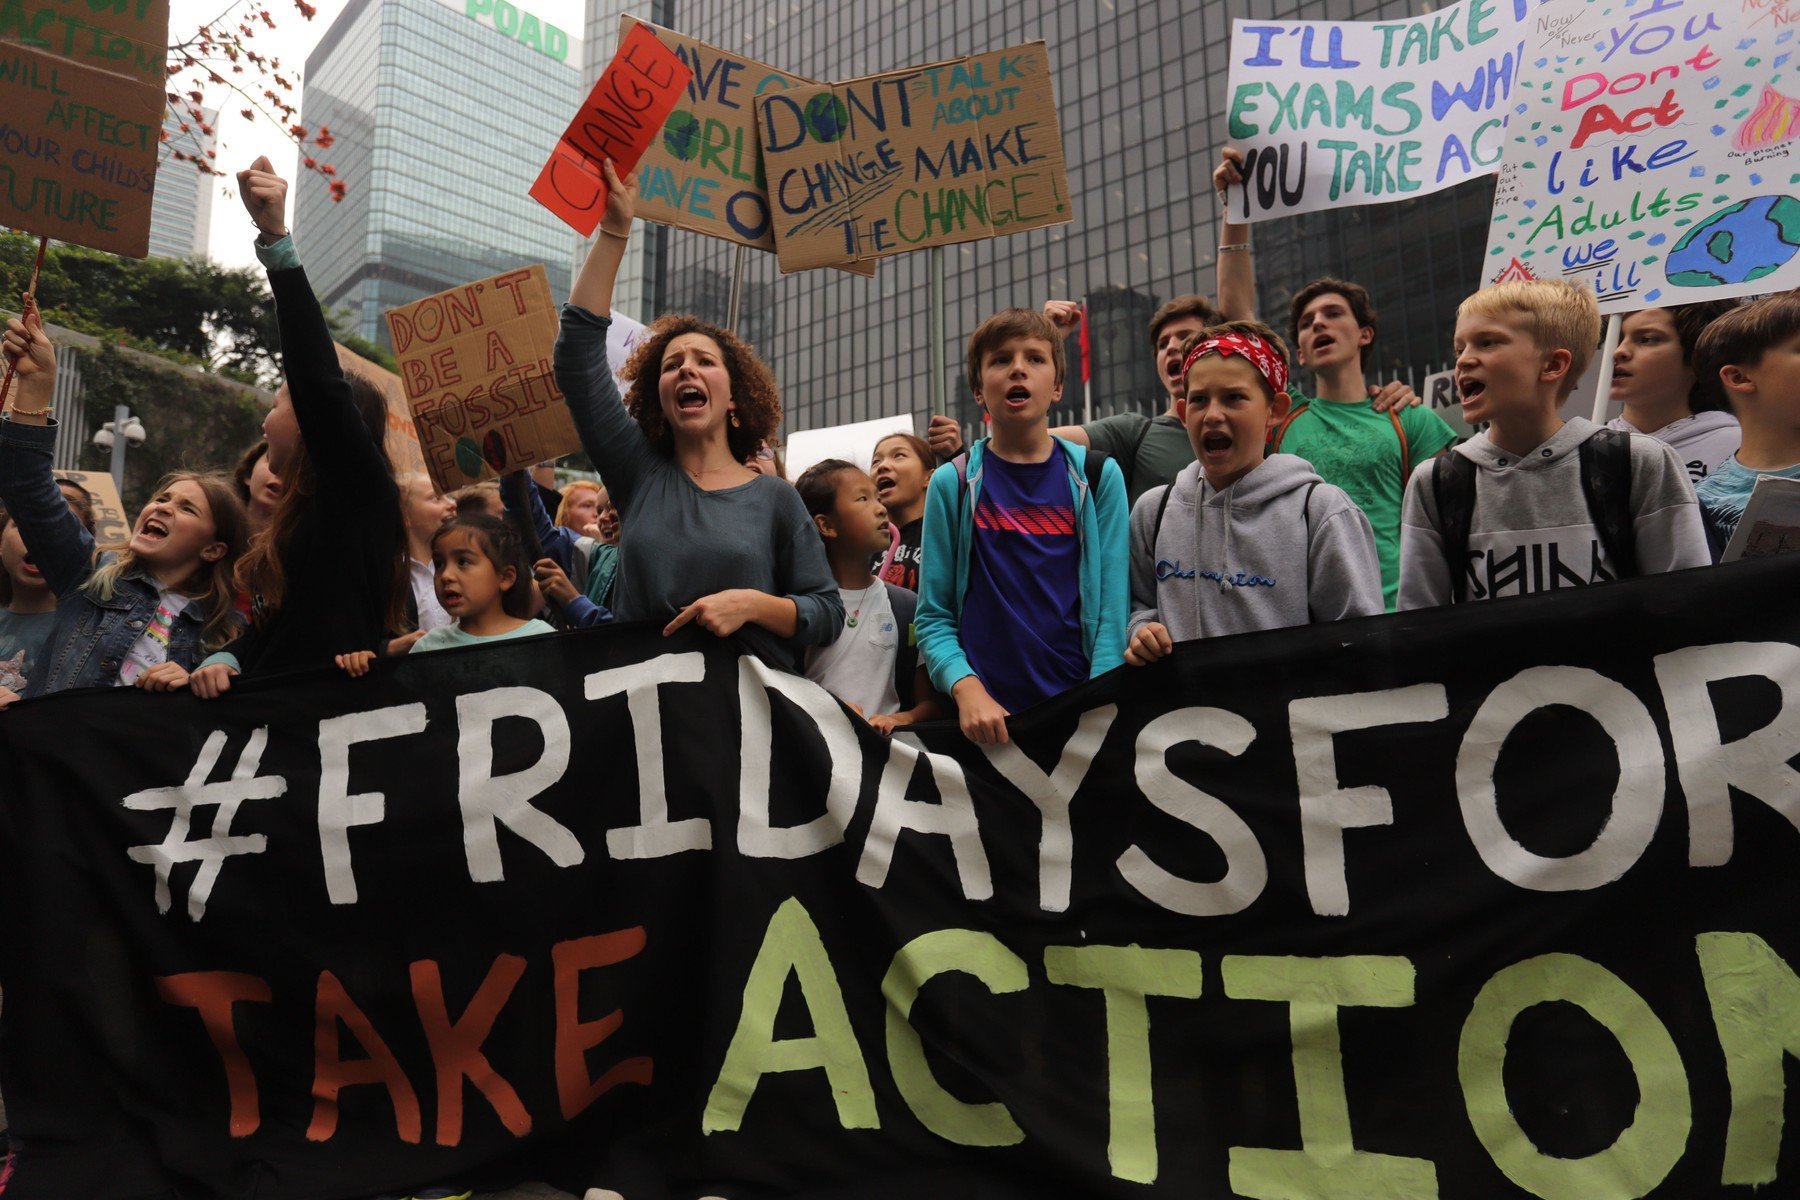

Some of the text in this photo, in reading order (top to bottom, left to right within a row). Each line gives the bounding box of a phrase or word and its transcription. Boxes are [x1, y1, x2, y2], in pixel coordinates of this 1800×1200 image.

[1242, 0, 1499, 69] I'LL TAKE
[923, 55, 1026, 97] TALK
[931, 86, 1021, 130] ABOUT
[1228, 80, 1422, 139] EXAMS
[1561, 44, 1721, 111] Dont
[45, 100, 151, 150] AFFECT
[551, 44, 674, 210] CHANGE
[1570, 88, 1684, 149] Act
[778, 122, 1046, 215] CHANGE MAKE
[1236, 141, 1308, 218] YOU
[1317, 139, 1422, 201] TAKE
[833, 214, 897, 255] THE
[1526, 187, 1704, 245] Adults
[390, 269, 531, 353] DON'T
[402, 330, 514, 398] BE A
[413, 358, 564, 444] FOSSIL
[154, 925, 654, 1147] TAKE
